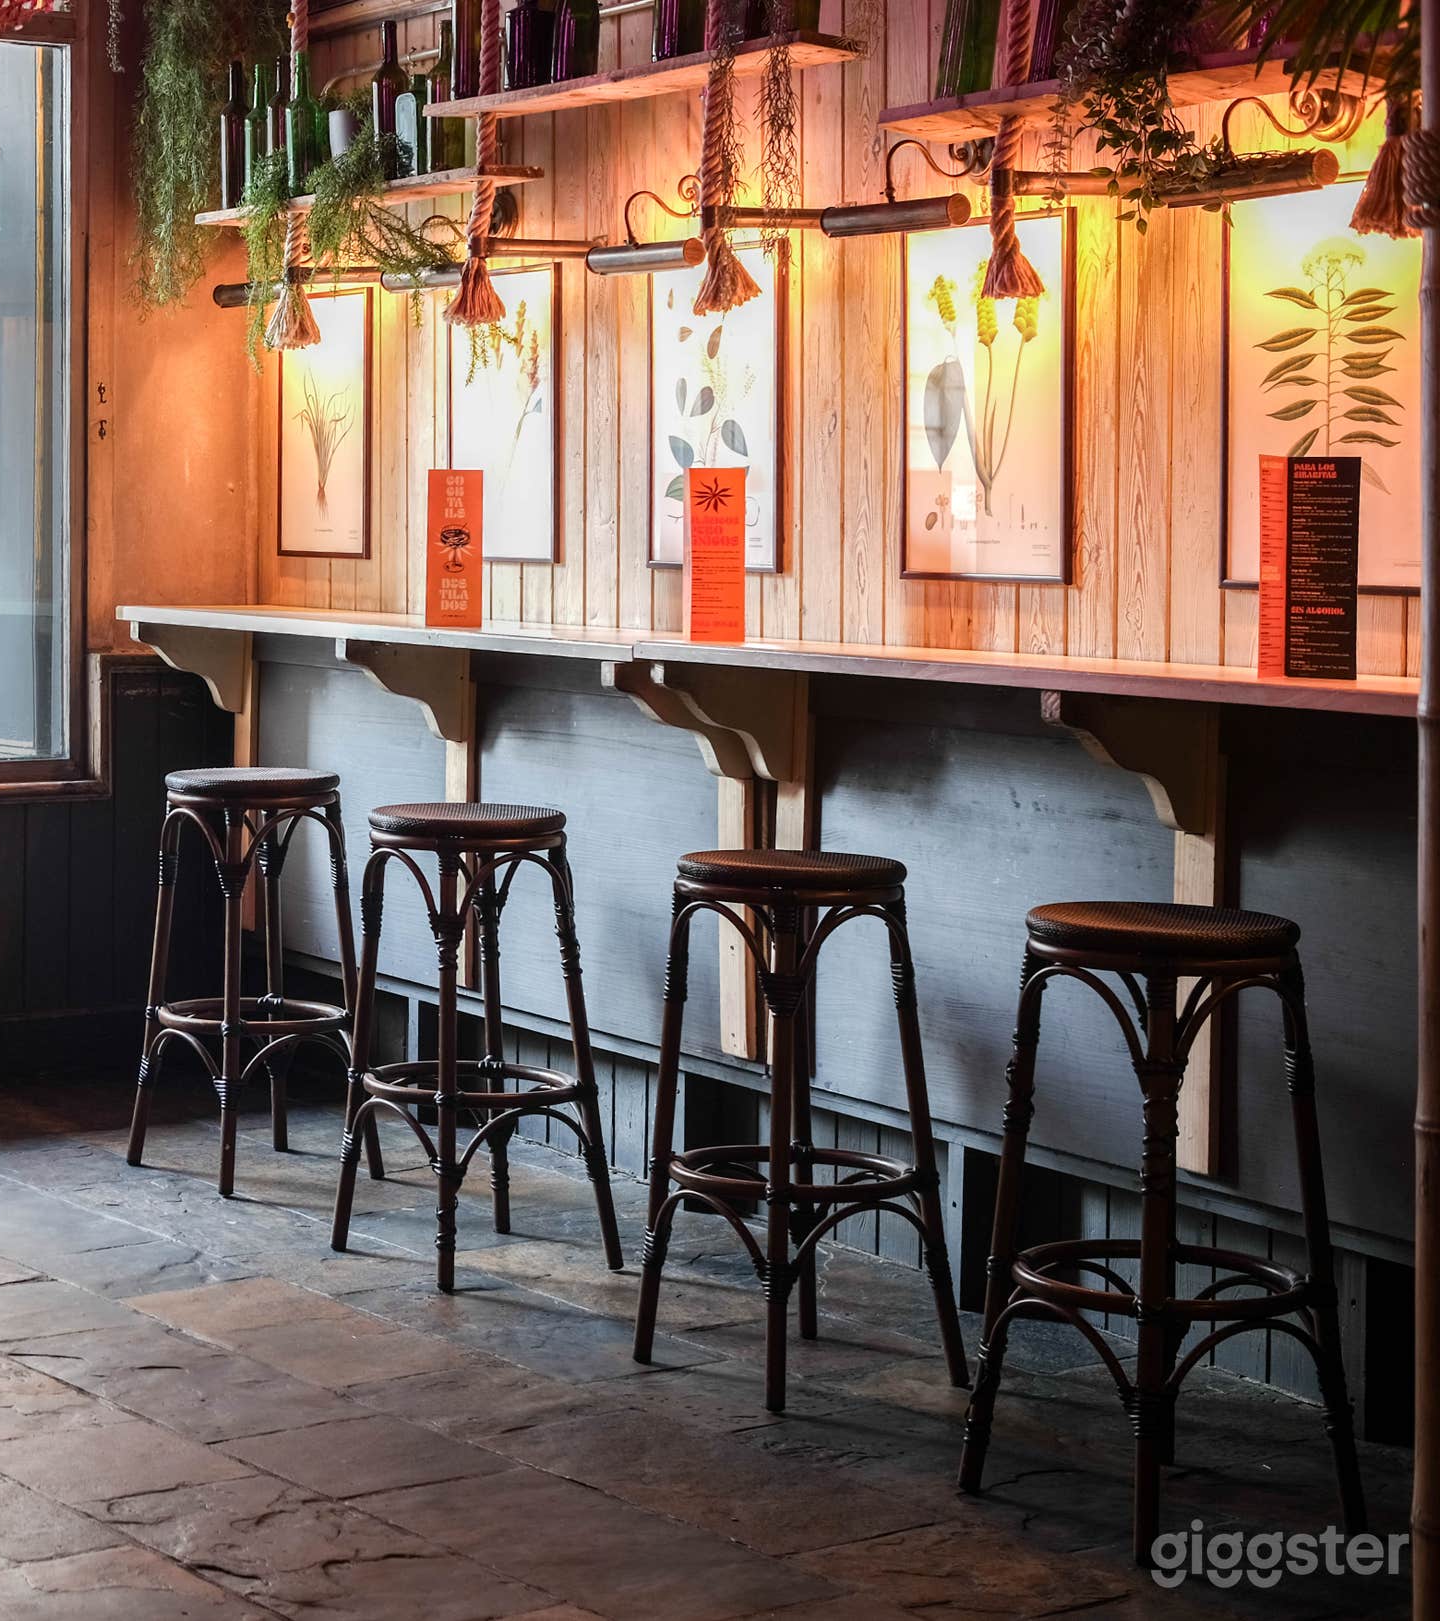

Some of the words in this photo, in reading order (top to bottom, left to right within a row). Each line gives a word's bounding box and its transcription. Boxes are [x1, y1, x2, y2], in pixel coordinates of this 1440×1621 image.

[1293, 463, 1316, 471] PARA
[1318, 463, 1336, 471] LOS
[446, 497, 463, 507] TA
[444, 508, 465, 518] ILS
[441, 578, 467, 589] DES
[439, 589, 469, 600] TILA
[441, 600, 468, 610] DOS
[1291, 606, 1304, 614] SIN
[1306, 606, 1345, 615] ALCOHOL
